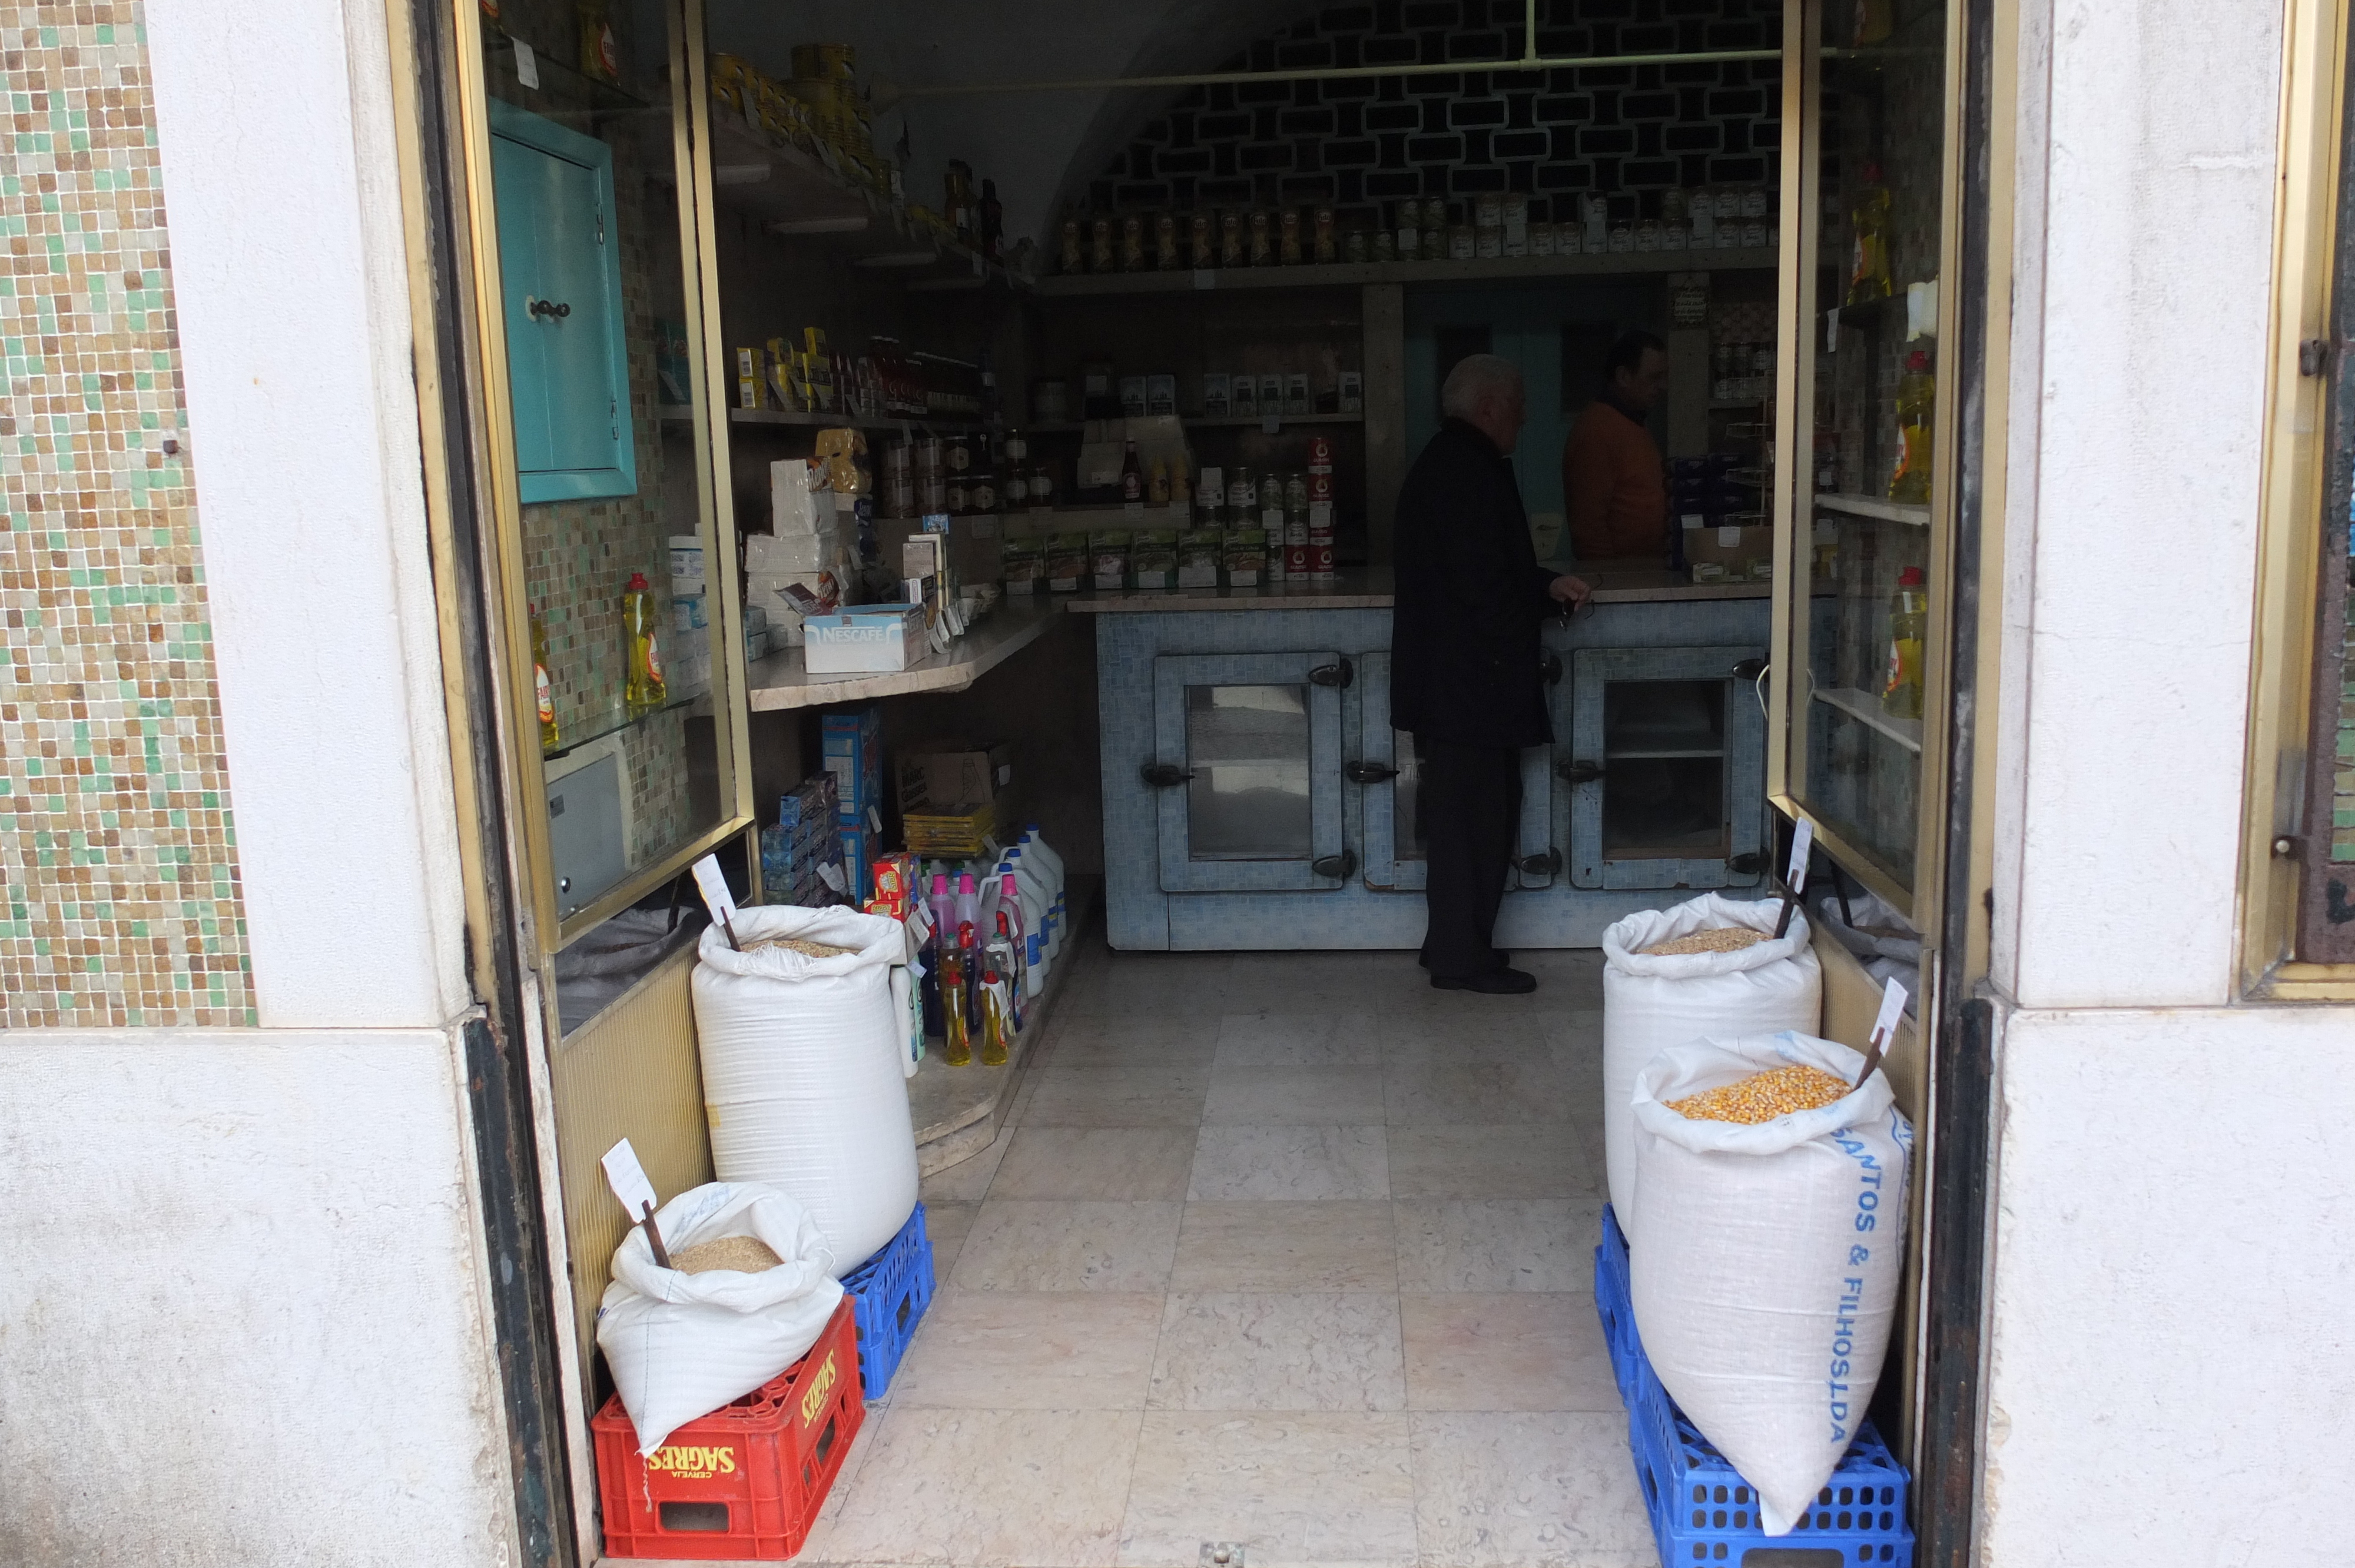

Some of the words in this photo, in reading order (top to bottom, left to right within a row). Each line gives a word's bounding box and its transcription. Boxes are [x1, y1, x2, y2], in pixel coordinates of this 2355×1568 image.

[822, 626, 883, 643] NESCAFÉ
[1830, 1127, 1882, 1231] SANTOS
[1848, 1244, 1869, 1266] &
[801, 1348, 837, 1429] SAGRES
[648, 1446, 736, 1474] SAGRES
[671, 1470, 712, 1479] CERVEJA
